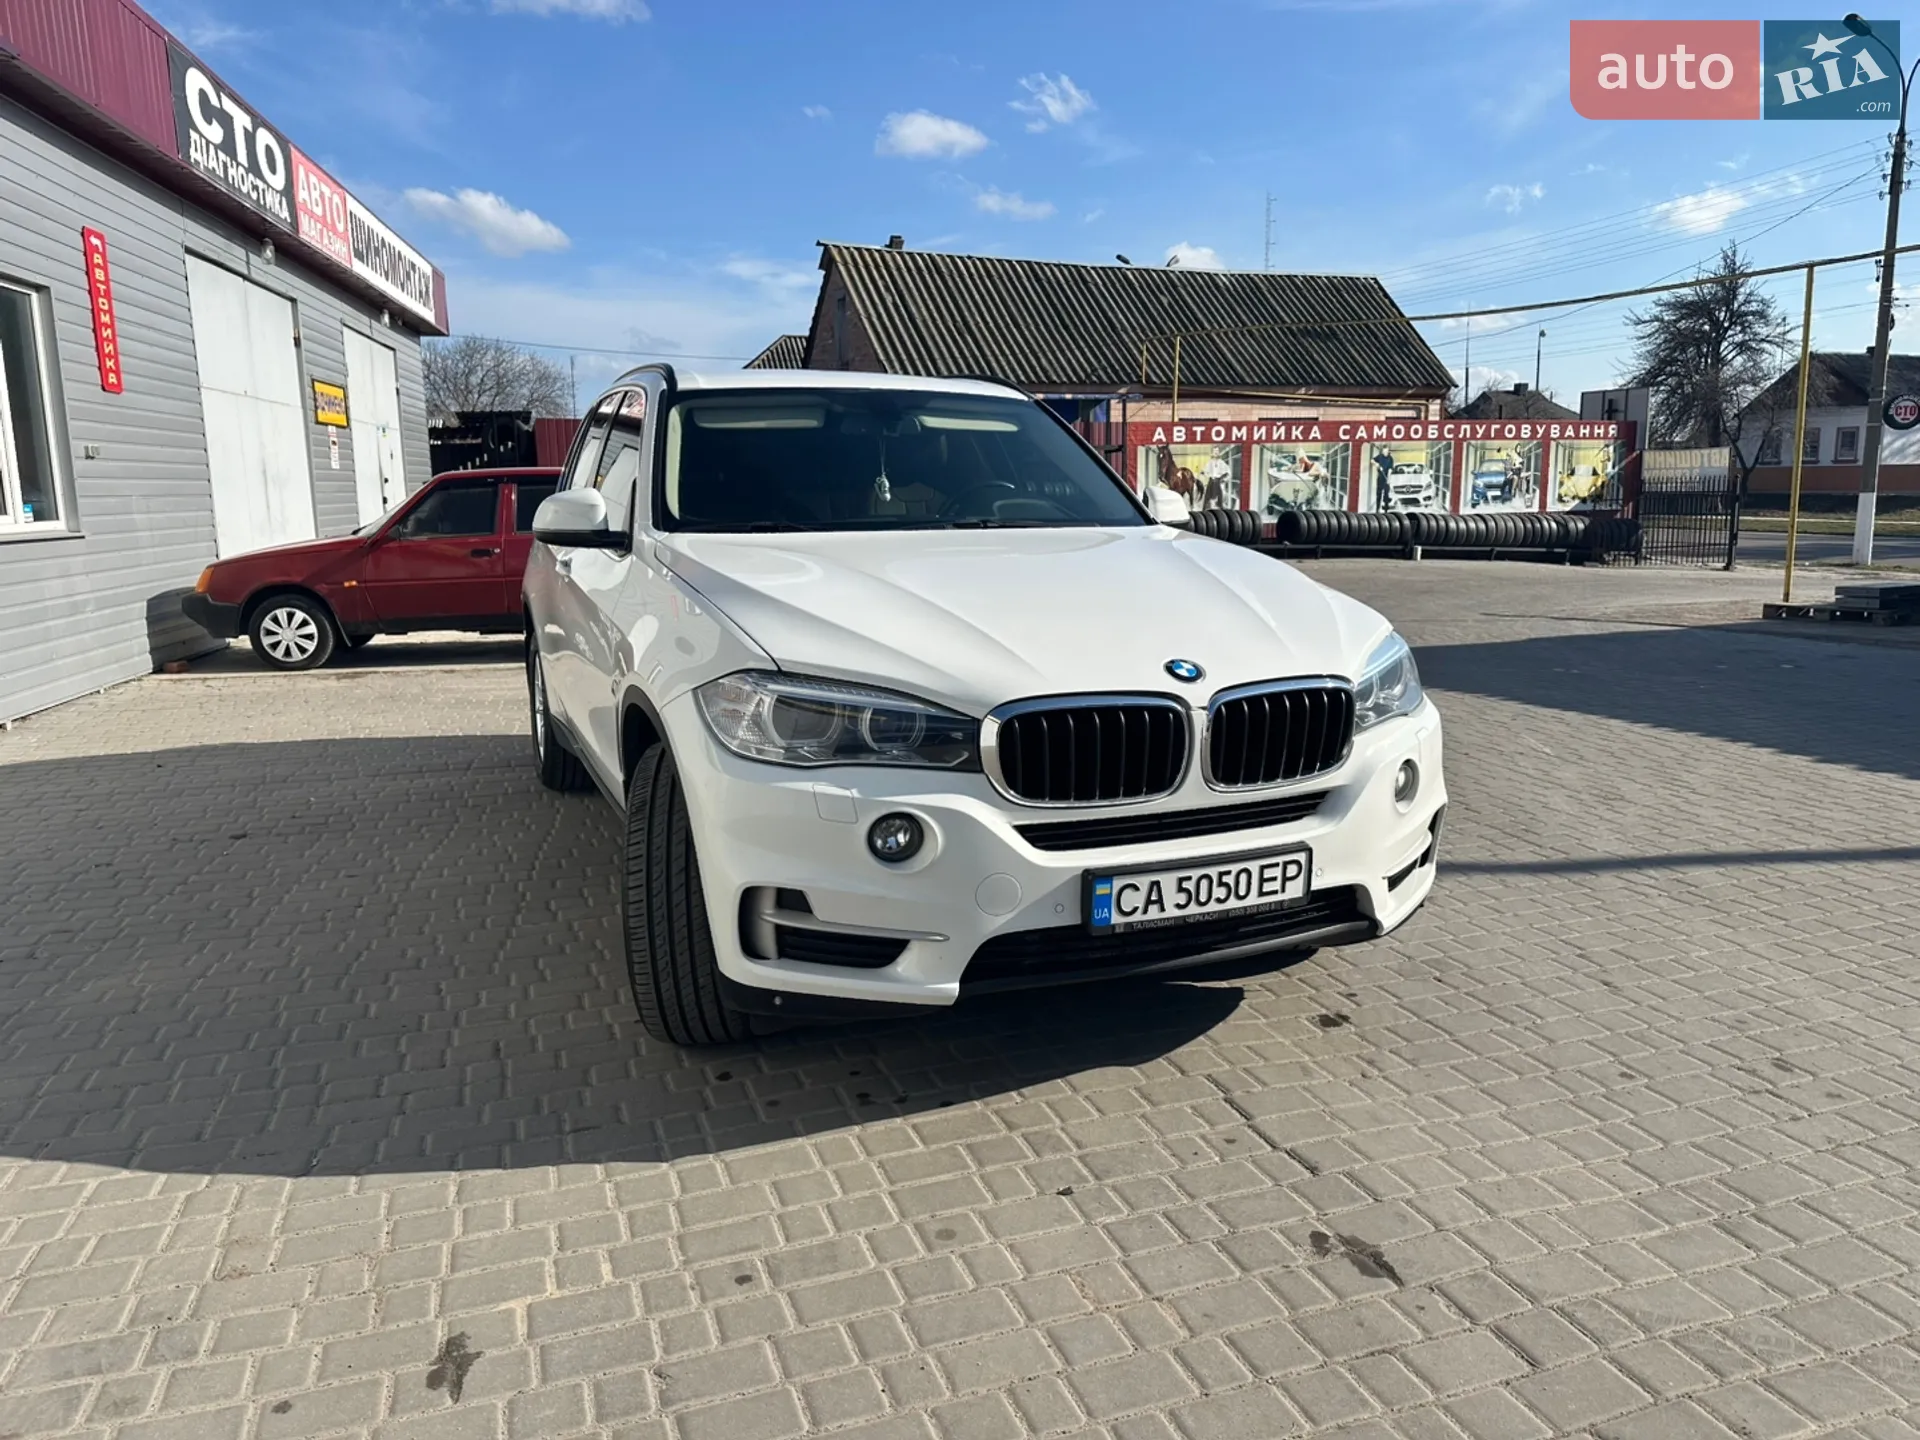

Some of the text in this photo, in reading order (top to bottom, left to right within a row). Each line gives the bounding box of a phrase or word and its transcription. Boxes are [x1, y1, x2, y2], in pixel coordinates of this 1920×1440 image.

[185, 67, 286, 191] СТО
[189, 128, 291, 223] ДІАГНОСТИКА
[298, 163, 345, 233] АВТО
[301, 213, 347, 260] МАГАЗИН
[350, 209, 433, 312] ШИНОМОНТАЖ
[1152, 421, 1619, 442] АВТОМИЙКА САМООБСЛУГОВУВАННЯ
[1894, 405, 1916, 417] СТО
[1094, 907, 1109, 920] UA
[1116, 858, 1303, 918] CA 5050 EP
